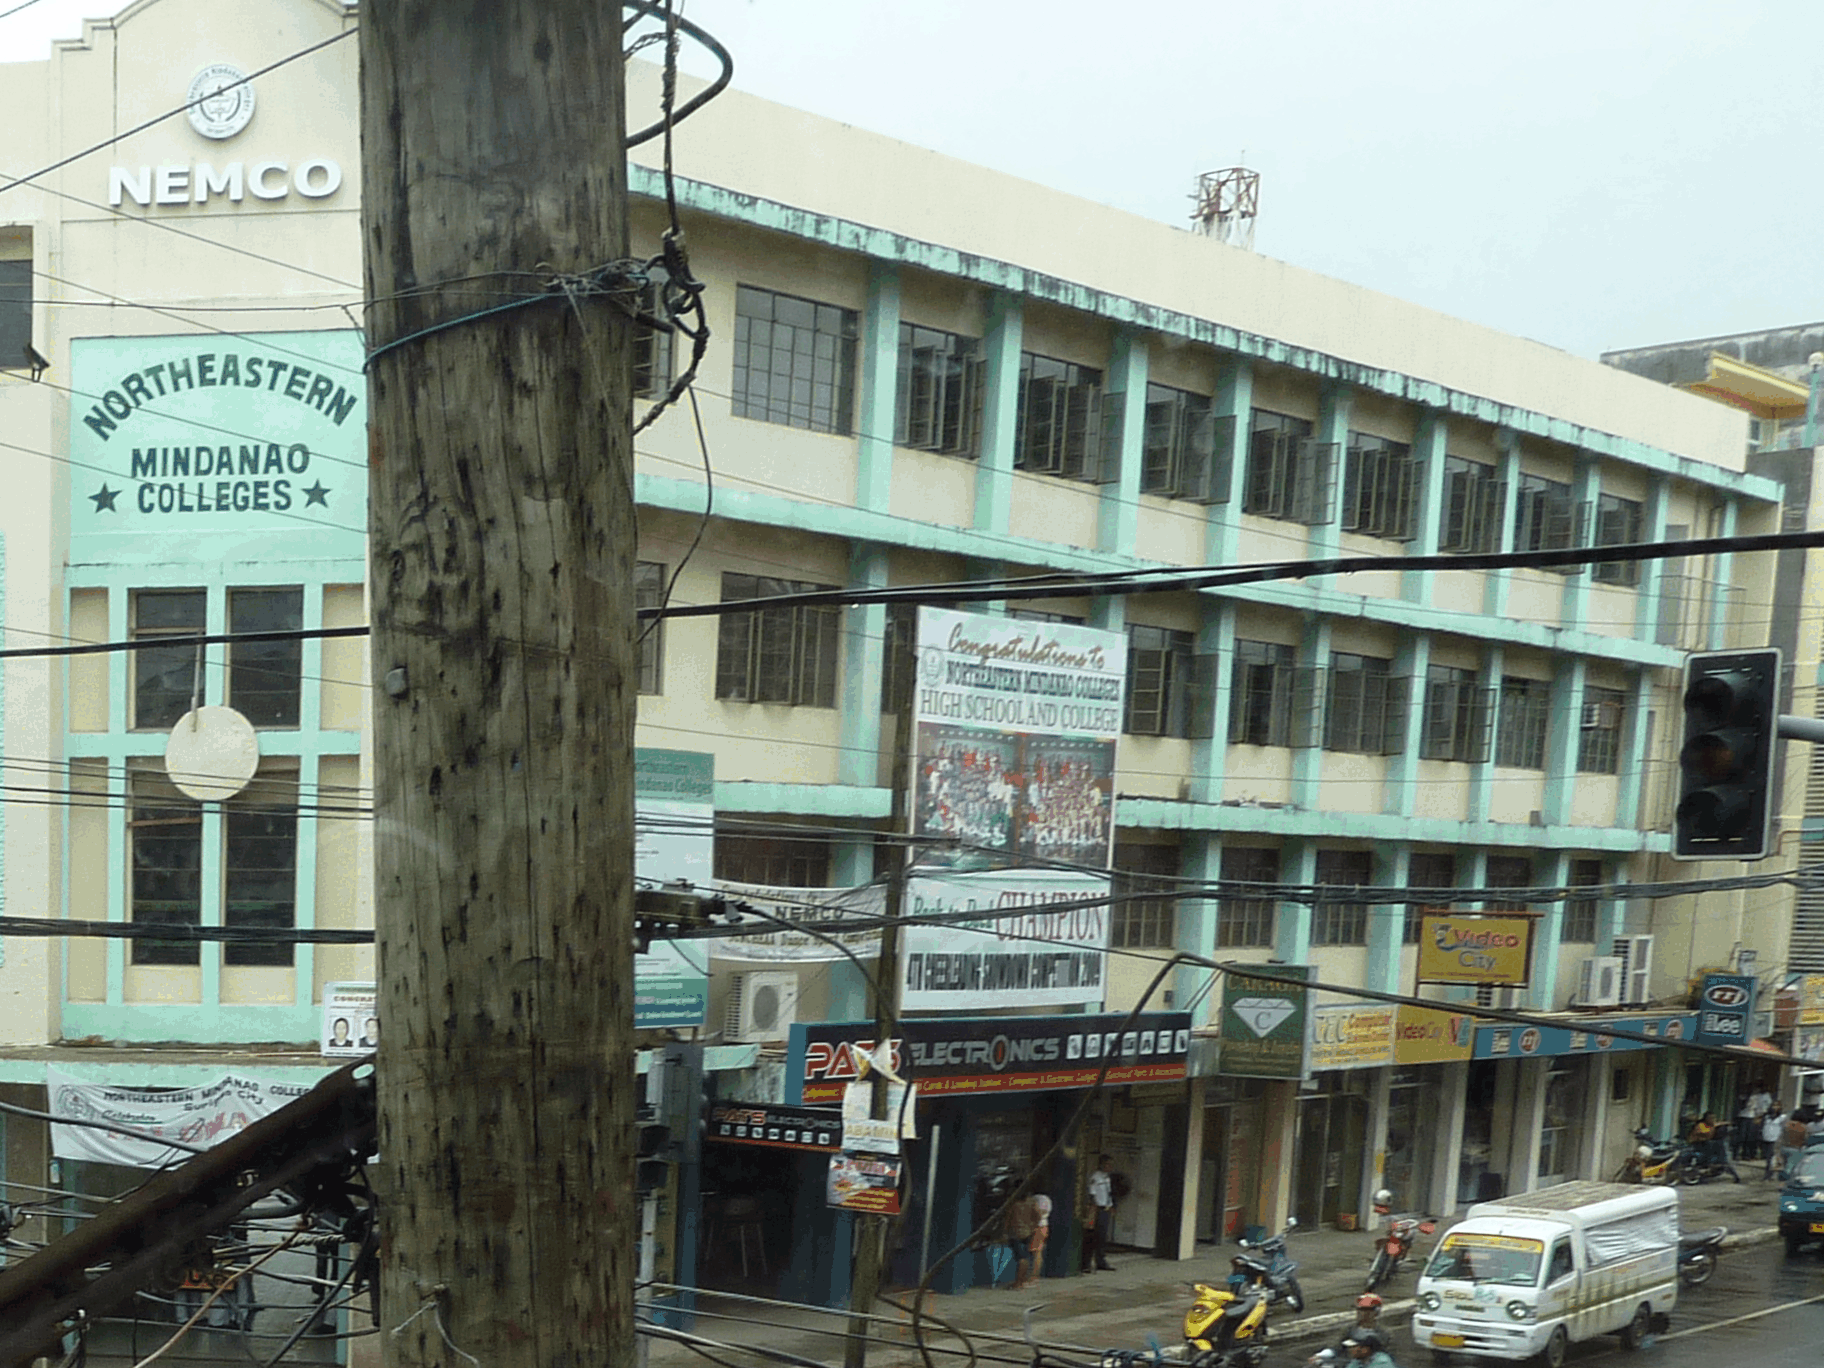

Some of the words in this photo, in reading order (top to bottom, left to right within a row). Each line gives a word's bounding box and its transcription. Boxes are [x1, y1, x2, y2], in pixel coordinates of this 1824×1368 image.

[109, 158, 343, 206] NEMCO
[82, 352, 359, 442] NORTHEASTERN
[130, 443, 311, 478] MINDANAO
[137, 479, 292, 514] COLLEGES
[948, 622, 1089, 668] Congratulations
[1089, 643, 1106, 669] to
[920, 689, 963, 718] HIGH
[965, 693, 1025, 724] SCHOOL
[1026, 701, 1059, 728] AND
[1061, 705, 1118, 732] COLLEGE
[996, 891, 1106, 941] CHAMPION
[1452, 928, 1521, 950] Video
[1457, 949, 1497, 971] City
[1254, 1011, 1272, 1030] C
[909, 1034, 1061, 1071] ELECTRONICS
[104, 1091, 193, 1104] NORTHEASTERN
